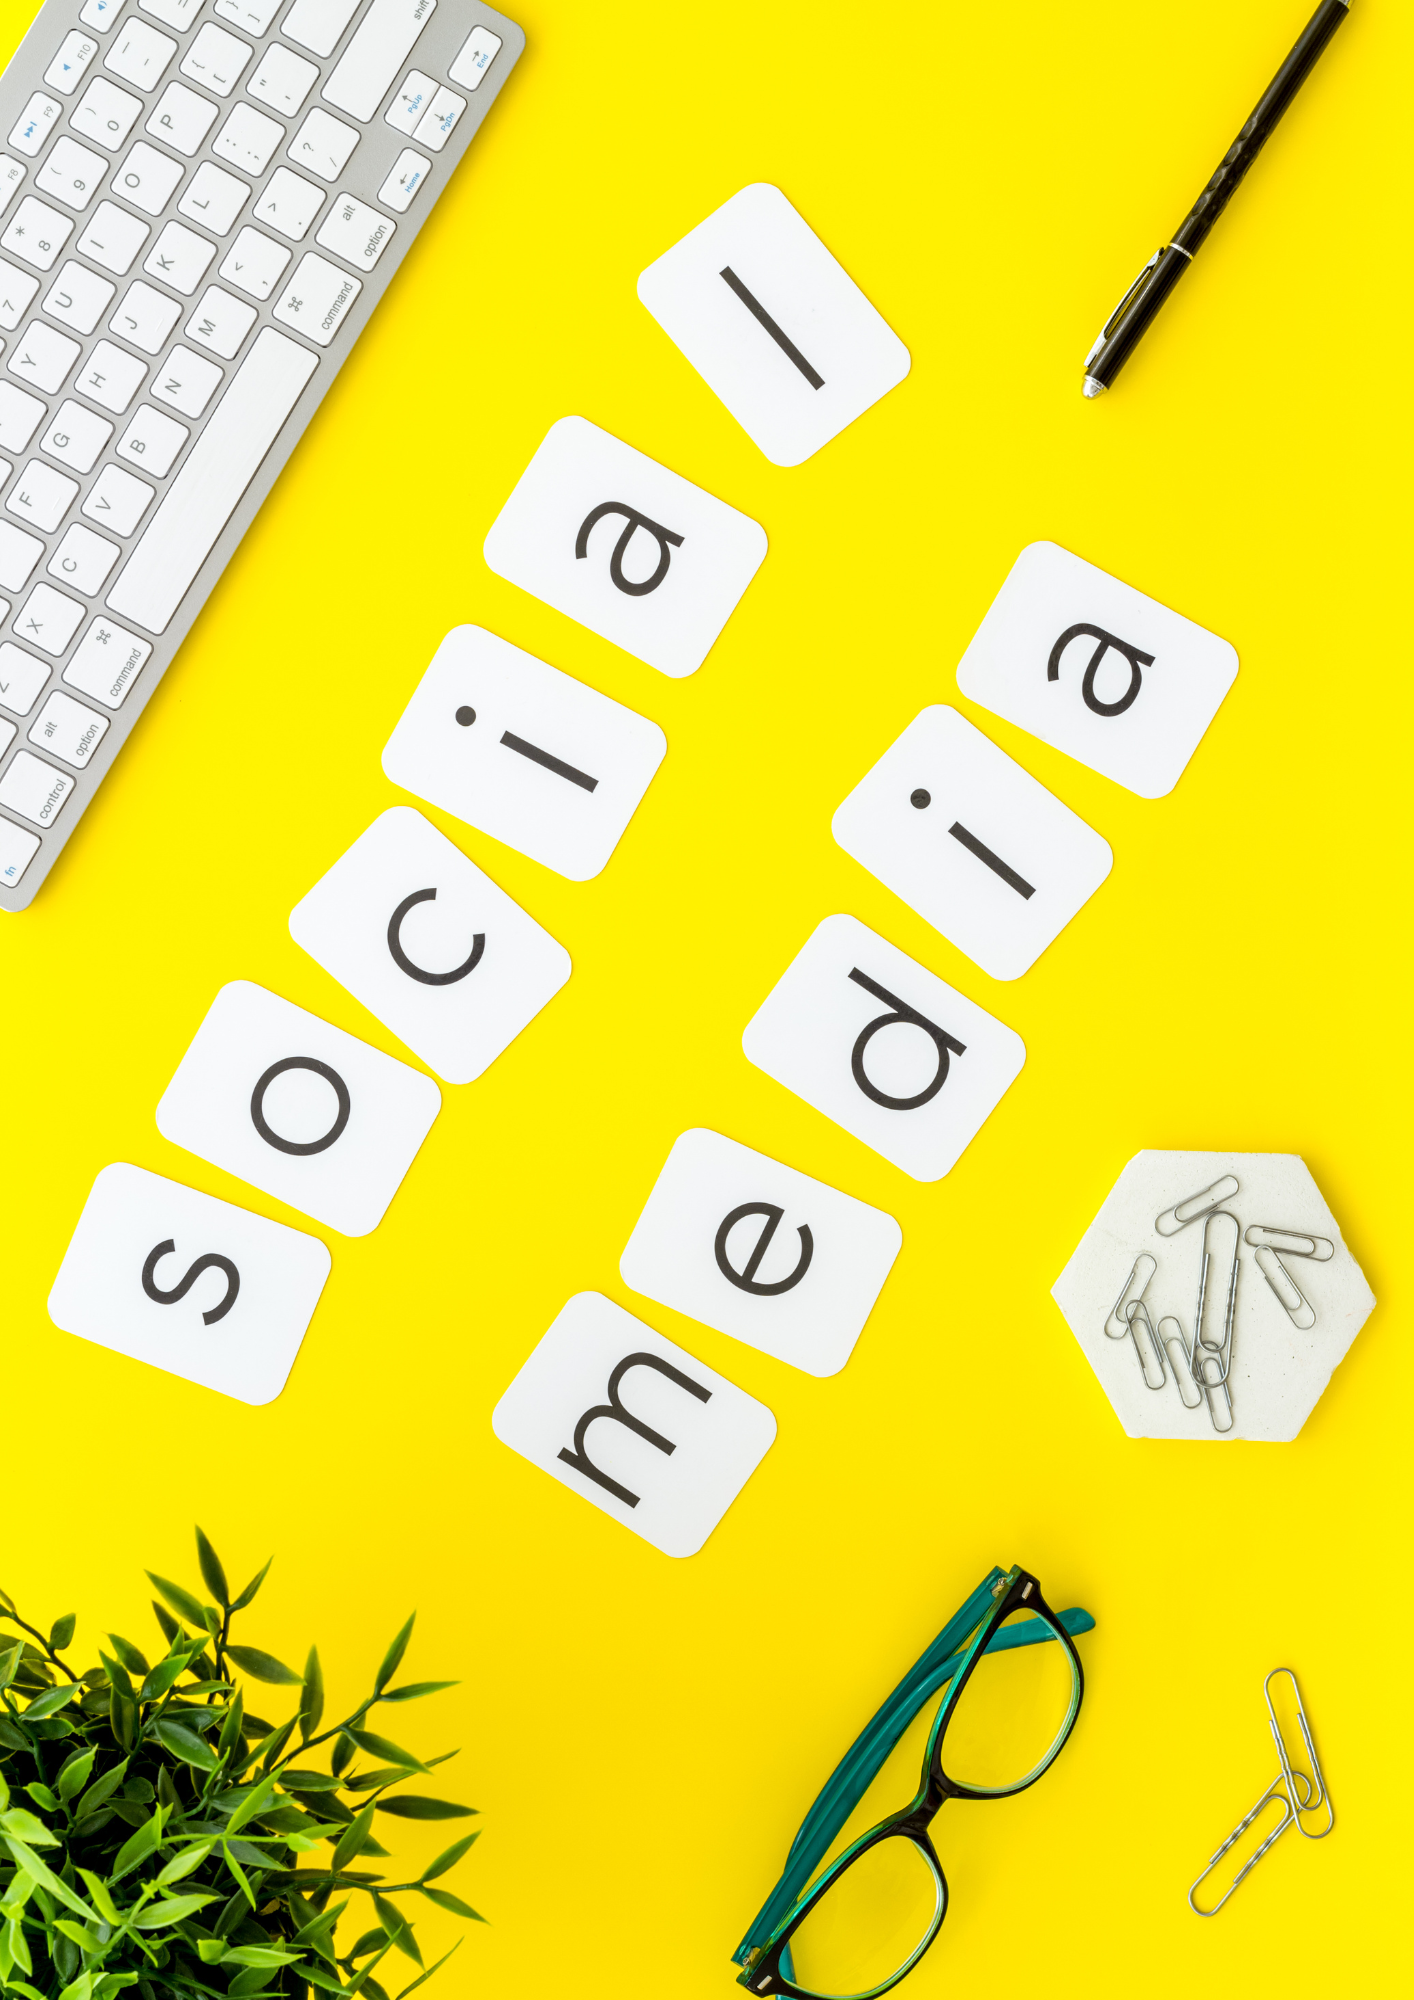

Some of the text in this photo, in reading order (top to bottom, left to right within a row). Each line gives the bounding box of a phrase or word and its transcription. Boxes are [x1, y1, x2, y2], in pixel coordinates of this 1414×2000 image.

[77, 44, 91, 60] F10
[477, 54, 488, 68] End
[408, 94, 422, 113] PgUp
[43, 106, 53, 118] F9
[160, 114, 173, 129] P
[441, 113, 455, 131] PgDn
[8, 169, 18, 180] F8
[125, 173, 140, 188] O
[73, 179, 85, 191] 9
[405, 173, 420, 193] Home
[192, 200, 210, 209] L
[343, 205, 355, 221] alt
[38, 240, 51, 251] 8
[364, 225, 387, 256] option
[156, 254, 175, 271] K
[2, 299, 14, 311] 7
[55, 292, 72, 308] U
[322, 281, 353, 330] command
[125, 316, 137, 330] J
[198, 319, 216, 336] M
[21, 353, 36, 366] Y
[89, 372, 106, 388] H
[165, 378, 182, 394] N
[53, 433, 70, 448] G
[130, 440, 146, 454] B
[19, 492, 32, 507] F
[95, 496, 111, 509] V
[62, 558, 77, 572] C
[26, 618, 43, 634] X
[110, 648, 141, 696] command
[45, 722, 57, 737] alt
[76, 724, 99, 756] option
[40, 779, 66, 819] control
[5, 867, 16, 876] fn
